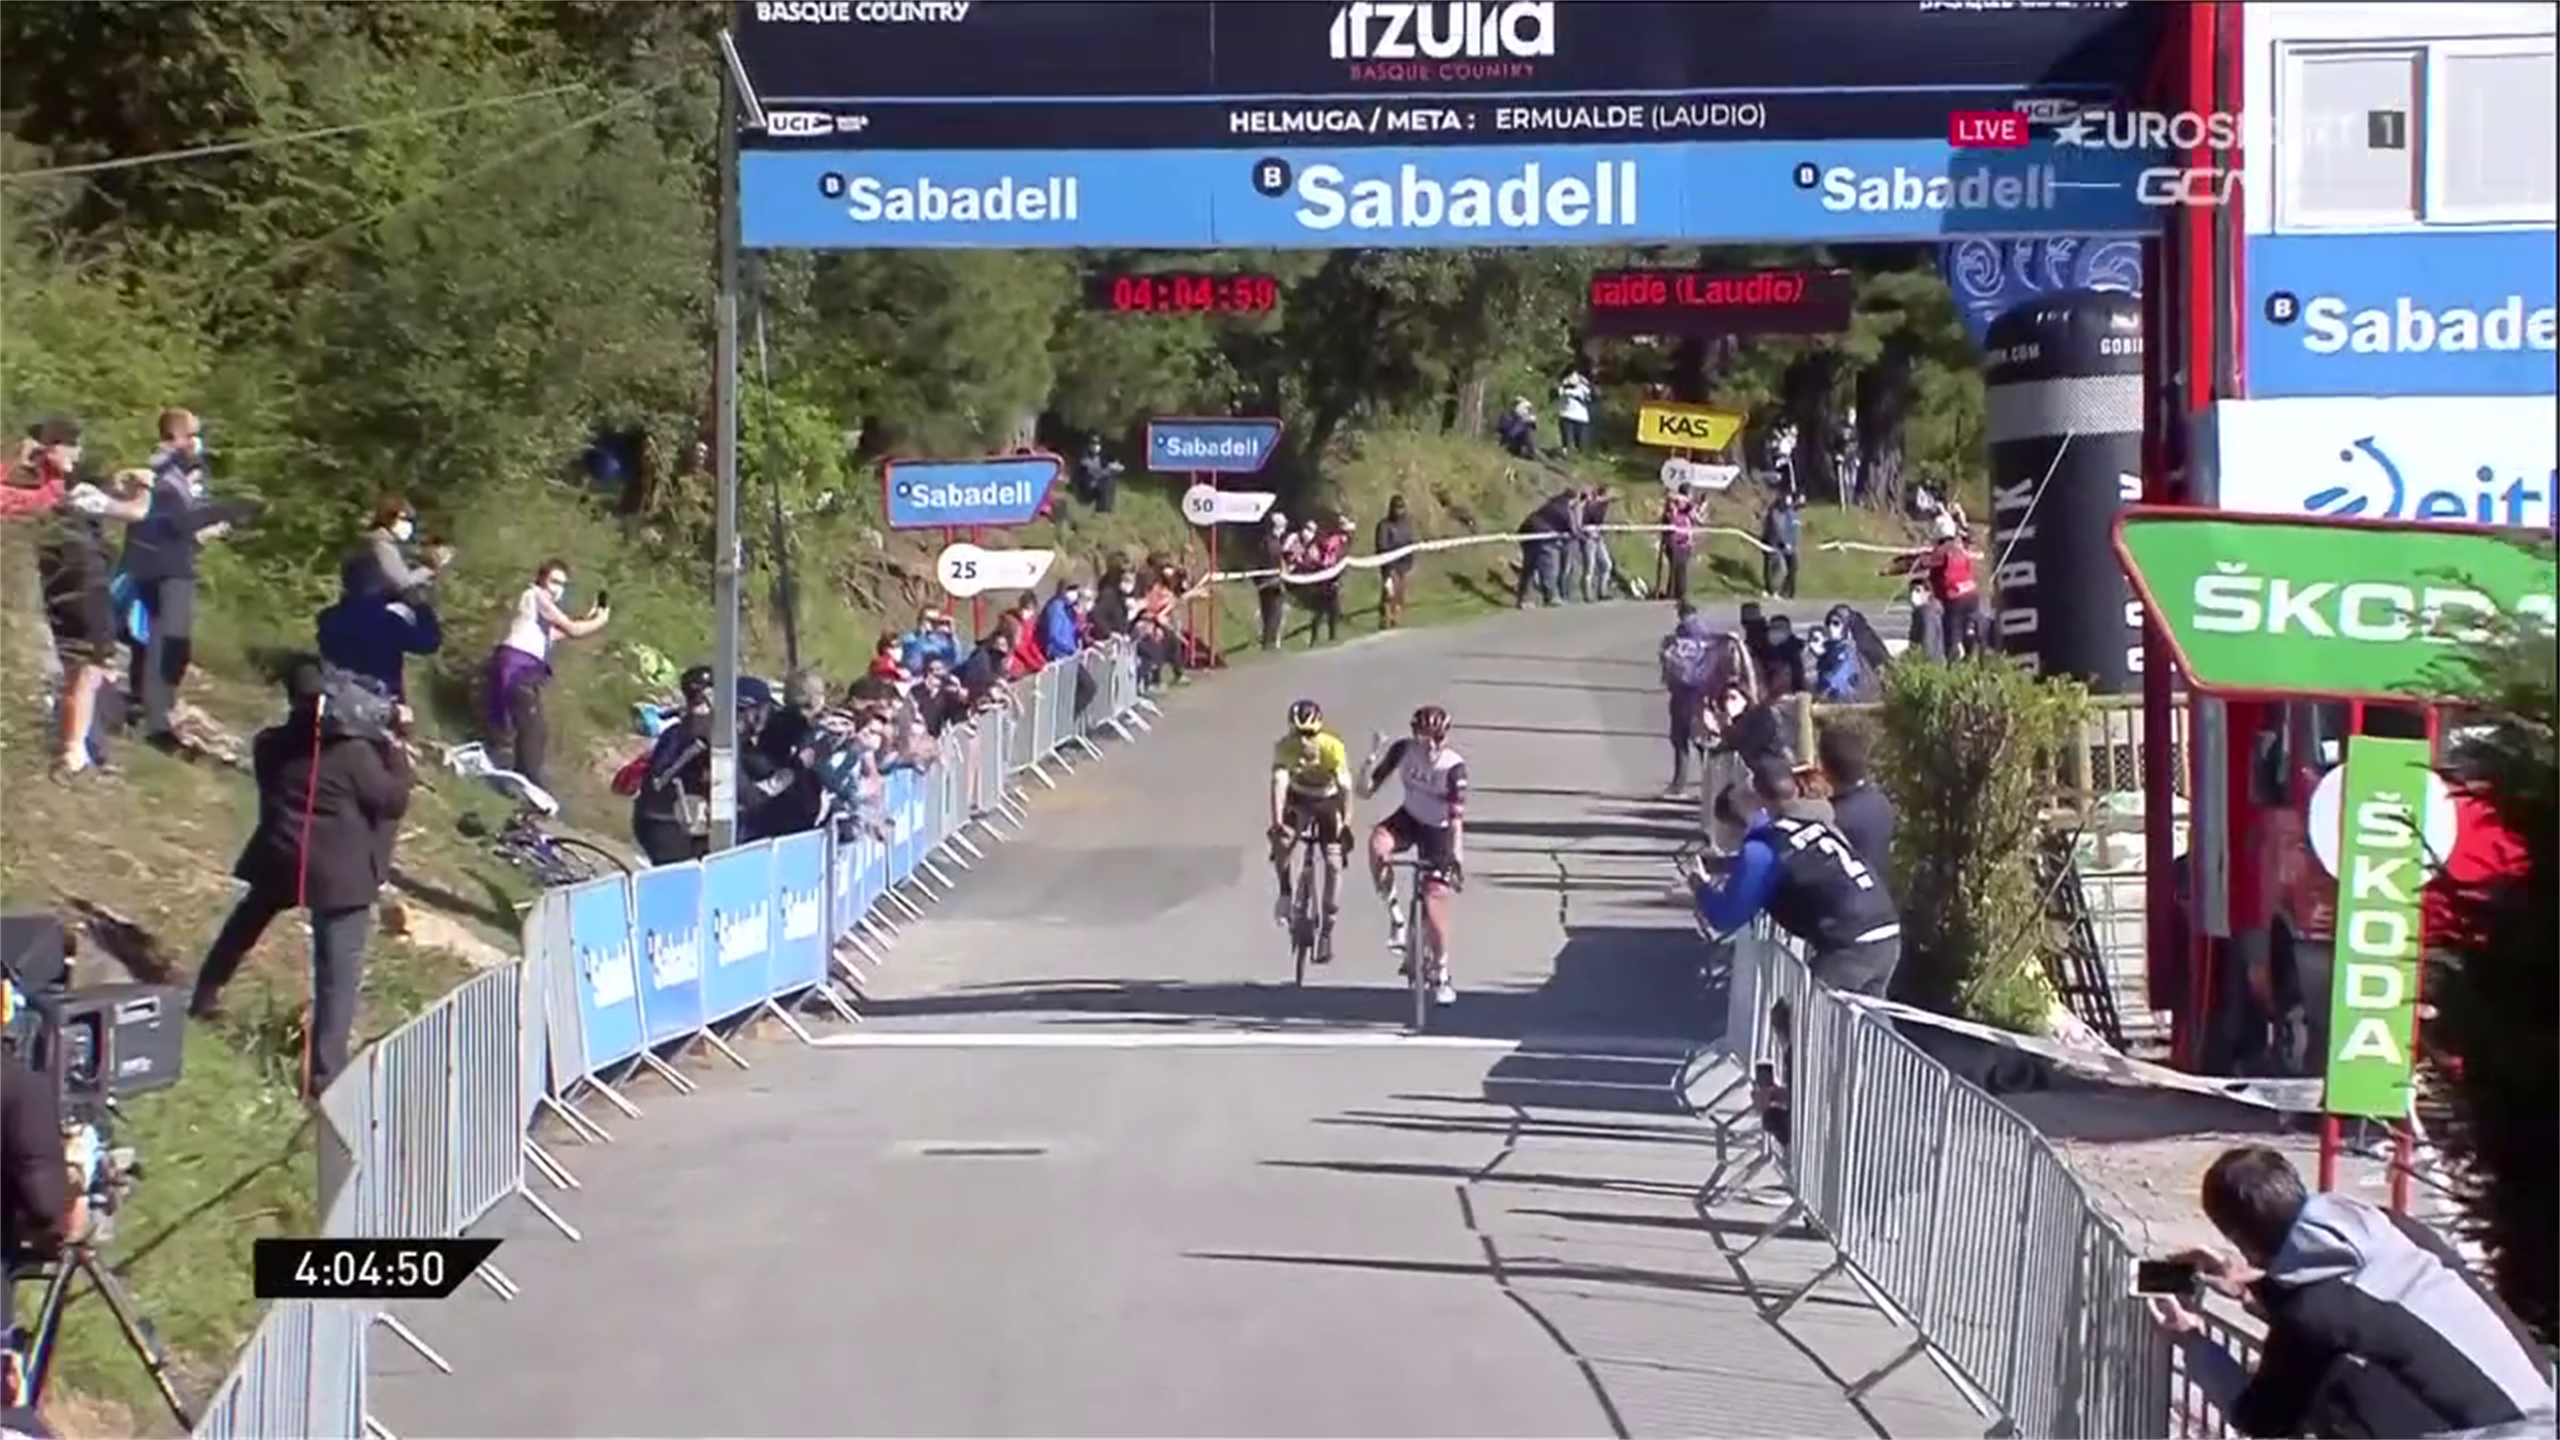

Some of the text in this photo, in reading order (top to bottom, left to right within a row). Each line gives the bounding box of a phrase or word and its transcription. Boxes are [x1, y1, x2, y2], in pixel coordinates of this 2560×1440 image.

[757, 1, 969, 22] BASQUE COUNTRY
[1351, 63, 1534, 80] BASQUE COUNTRY
[773, 117, 808, 131] UCI
[1230, 110, 1363, 133] HELMUGA
[1387, 110, 1460, 132] META
[1496, 107, 1643, 130] ERMUALDE
[1651, 103, 1767, 129] (LAUDIO)
[848, 176, 1078, 222] Sabadell
[1296, 161, 1637, 229] Sabadell
[1821, 164, 2056, 212] Sabadell
[1676, 273, 1804, 304] (Laudio)
[1659, 415, 1709, 437] KAS
[1165, 436, 1259, 458] Sabadell
[911, 481, 1032, 509] Sabadell
[1192, 498, 1214, 513] 50
[2415, 465, 2556, 525] eit
[951, 560, 977, 580] 25
[2337, 791, 2413, 1064] ŠKODA
